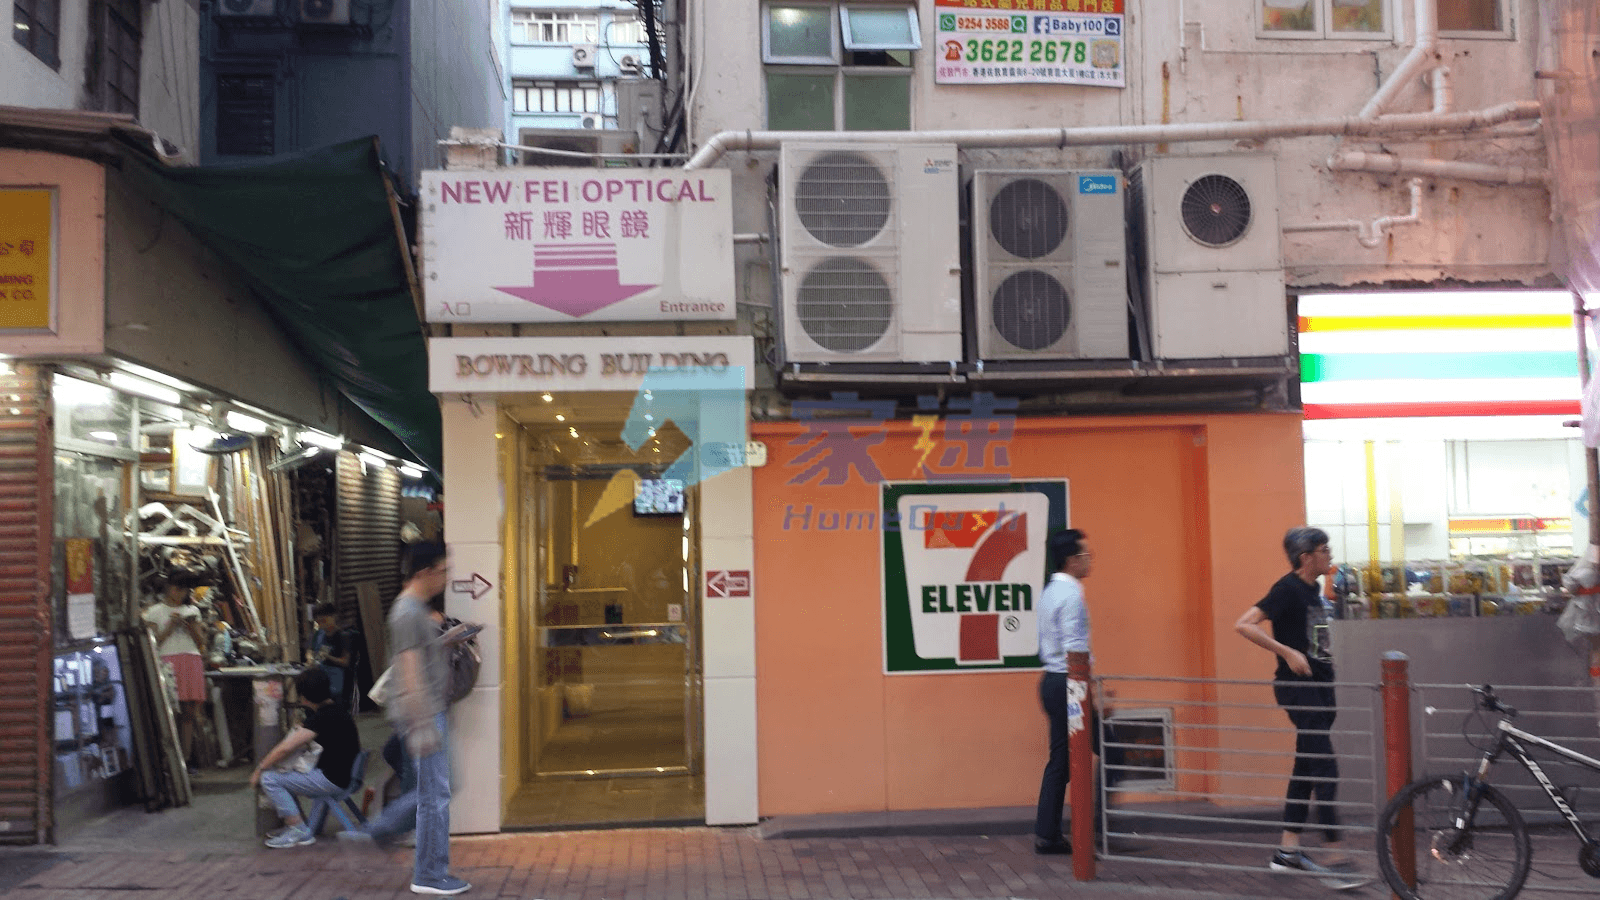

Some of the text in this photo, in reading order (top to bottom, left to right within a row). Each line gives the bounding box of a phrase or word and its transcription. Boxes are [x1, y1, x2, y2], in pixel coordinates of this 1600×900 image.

[958, 17, 1010, 31] 9254 3588
[965, 39, 1087, 64] 3622 2678
[441, 178, 715, 204] NEW FEI OPTICAL
[504, 209, 649, 240] 新輝眼鏡
[439, 301, 471, 316] 入口
[659, 300, 726, 313] Entrance
[456, 352, 730, 378] BOWRING BUILDING
